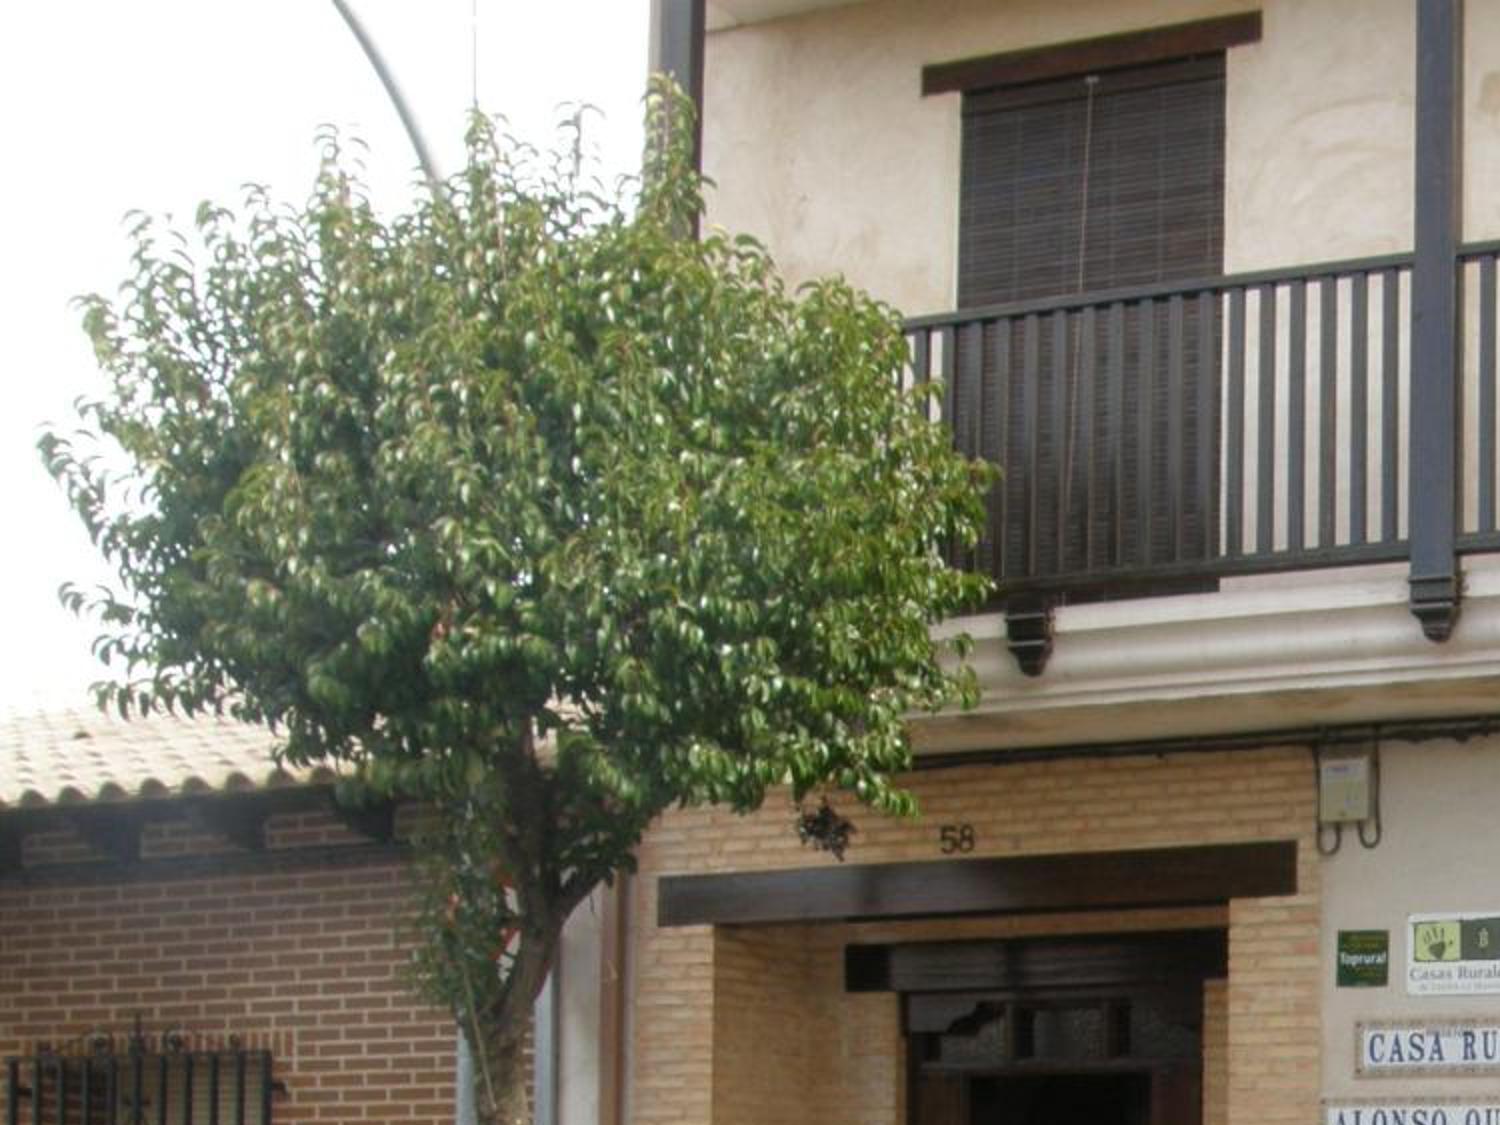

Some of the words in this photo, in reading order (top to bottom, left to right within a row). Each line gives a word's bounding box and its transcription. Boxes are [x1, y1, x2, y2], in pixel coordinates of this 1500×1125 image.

[940, 824, 975, 854] 58
[1340, 951, 1387, 967] Toprural
[1369, 1032, 1445, 1062] CASA
